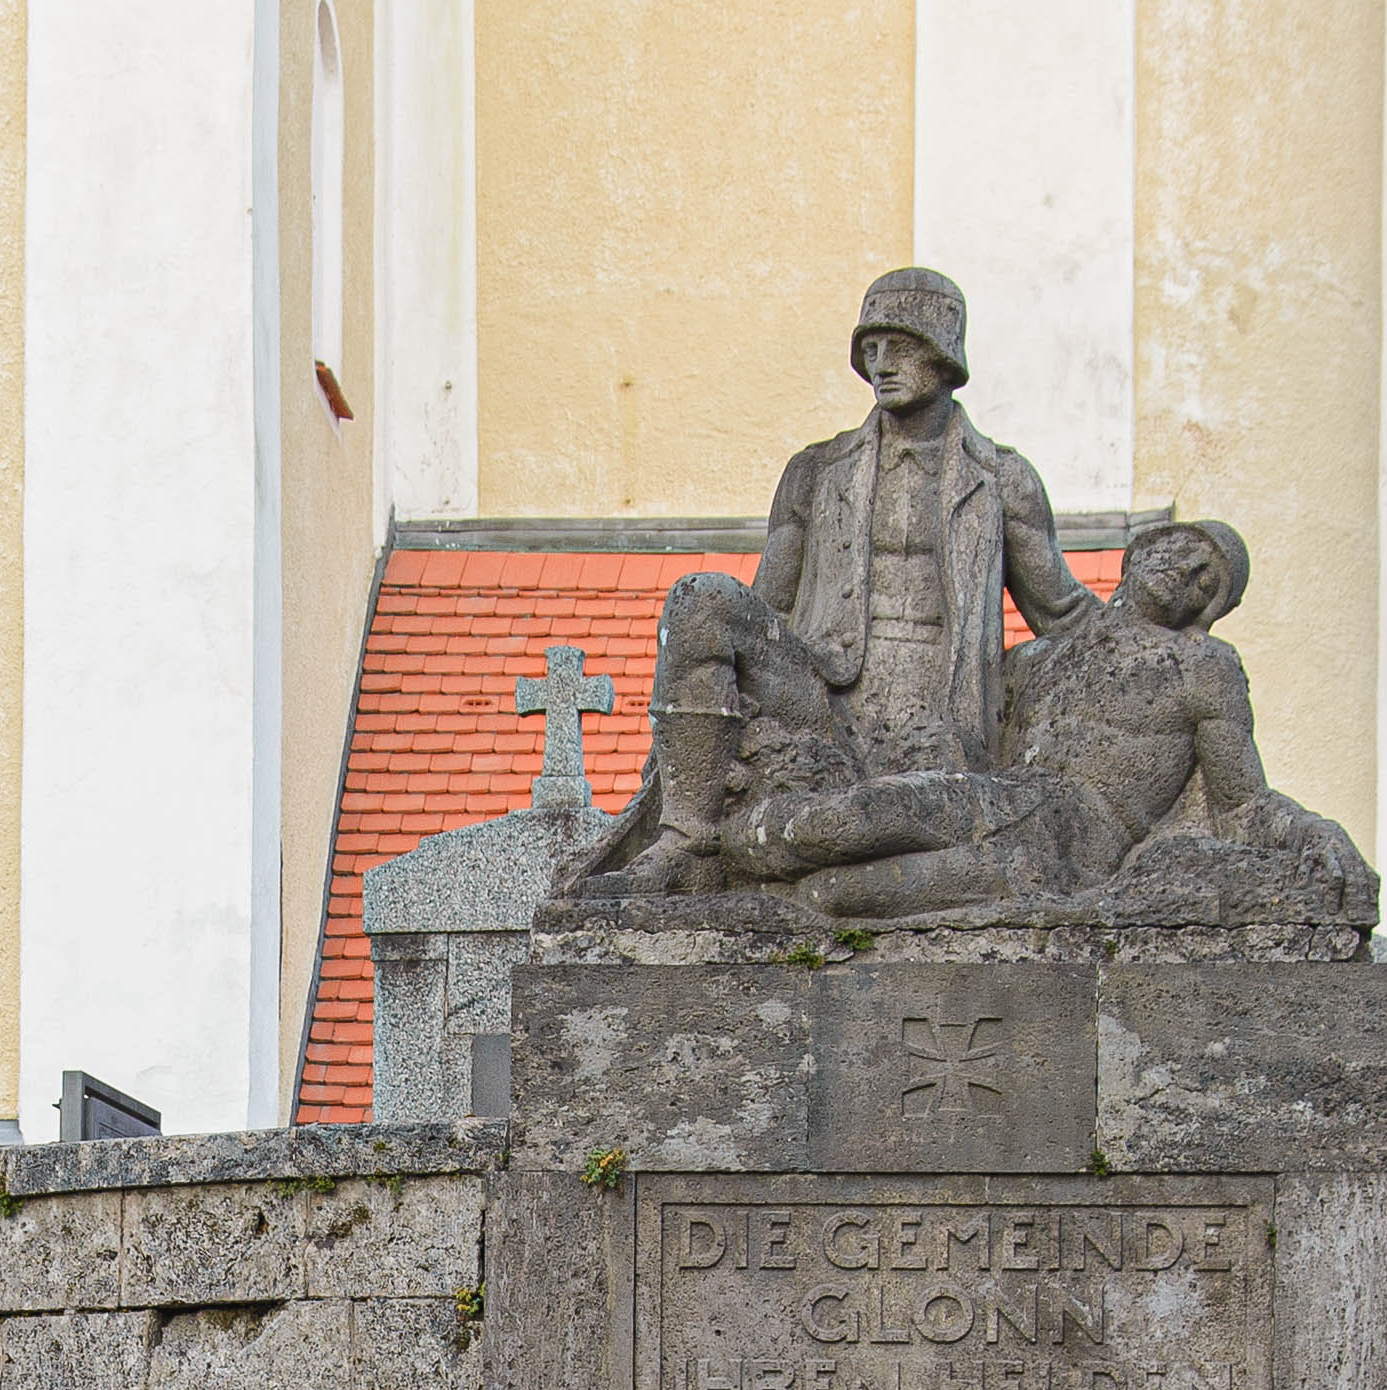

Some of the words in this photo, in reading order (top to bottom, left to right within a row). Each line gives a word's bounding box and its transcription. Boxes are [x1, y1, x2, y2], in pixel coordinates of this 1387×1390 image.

[678, 1211, 796, 1270] DIE
[823, 1211, 1233, 1272] GEMEINDE
[801, 1285, 1105, 1345] GLONN
